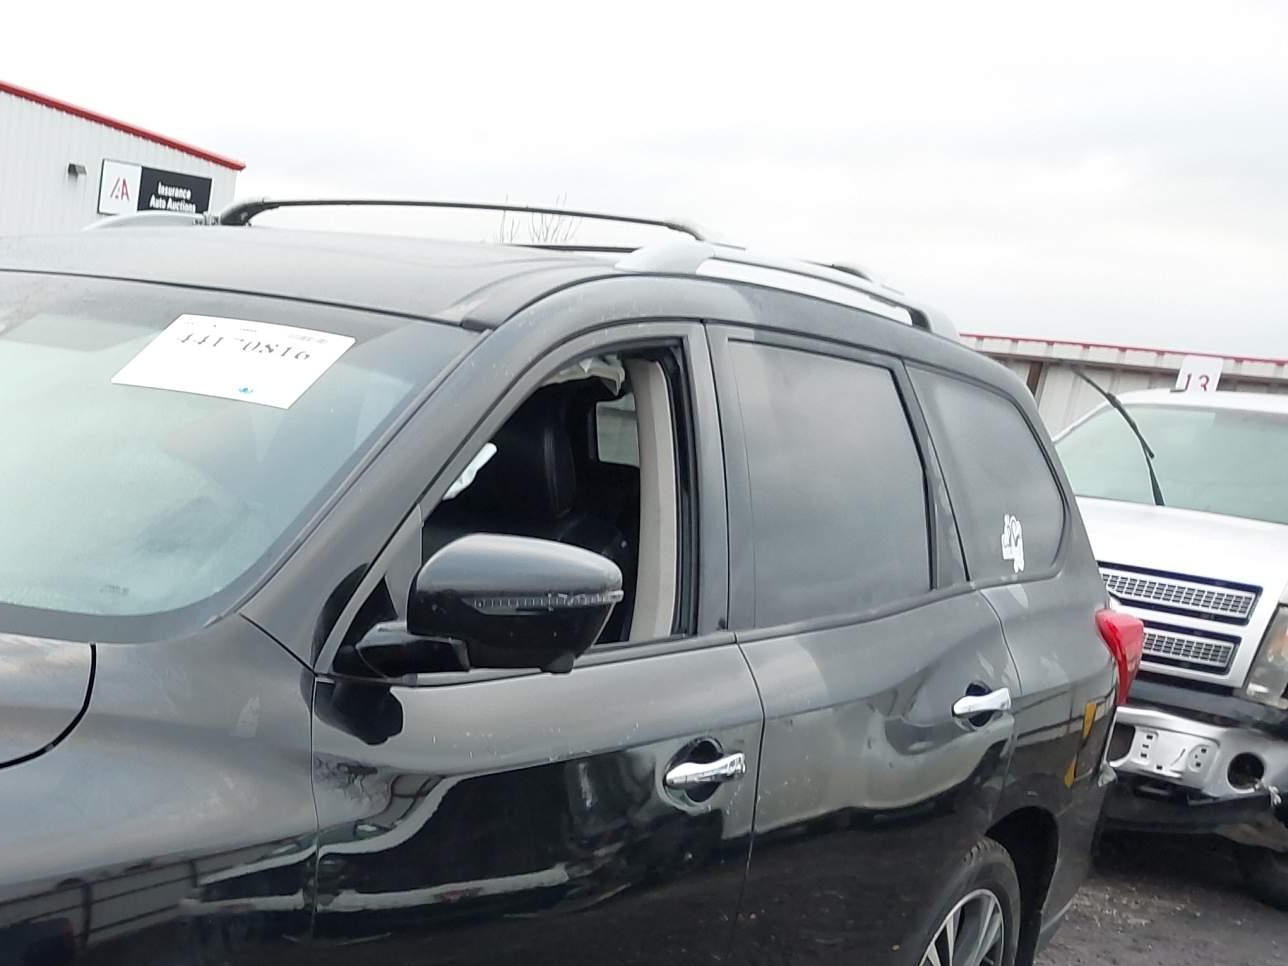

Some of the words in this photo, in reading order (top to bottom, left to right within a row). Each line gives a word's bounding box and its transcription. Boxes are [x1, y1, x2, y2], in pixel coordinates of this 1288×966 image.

[158, 181, 192, 200] Insurance
[149, 194, 167, 209] Auto
[167, 198, 197, 213] Auctions
